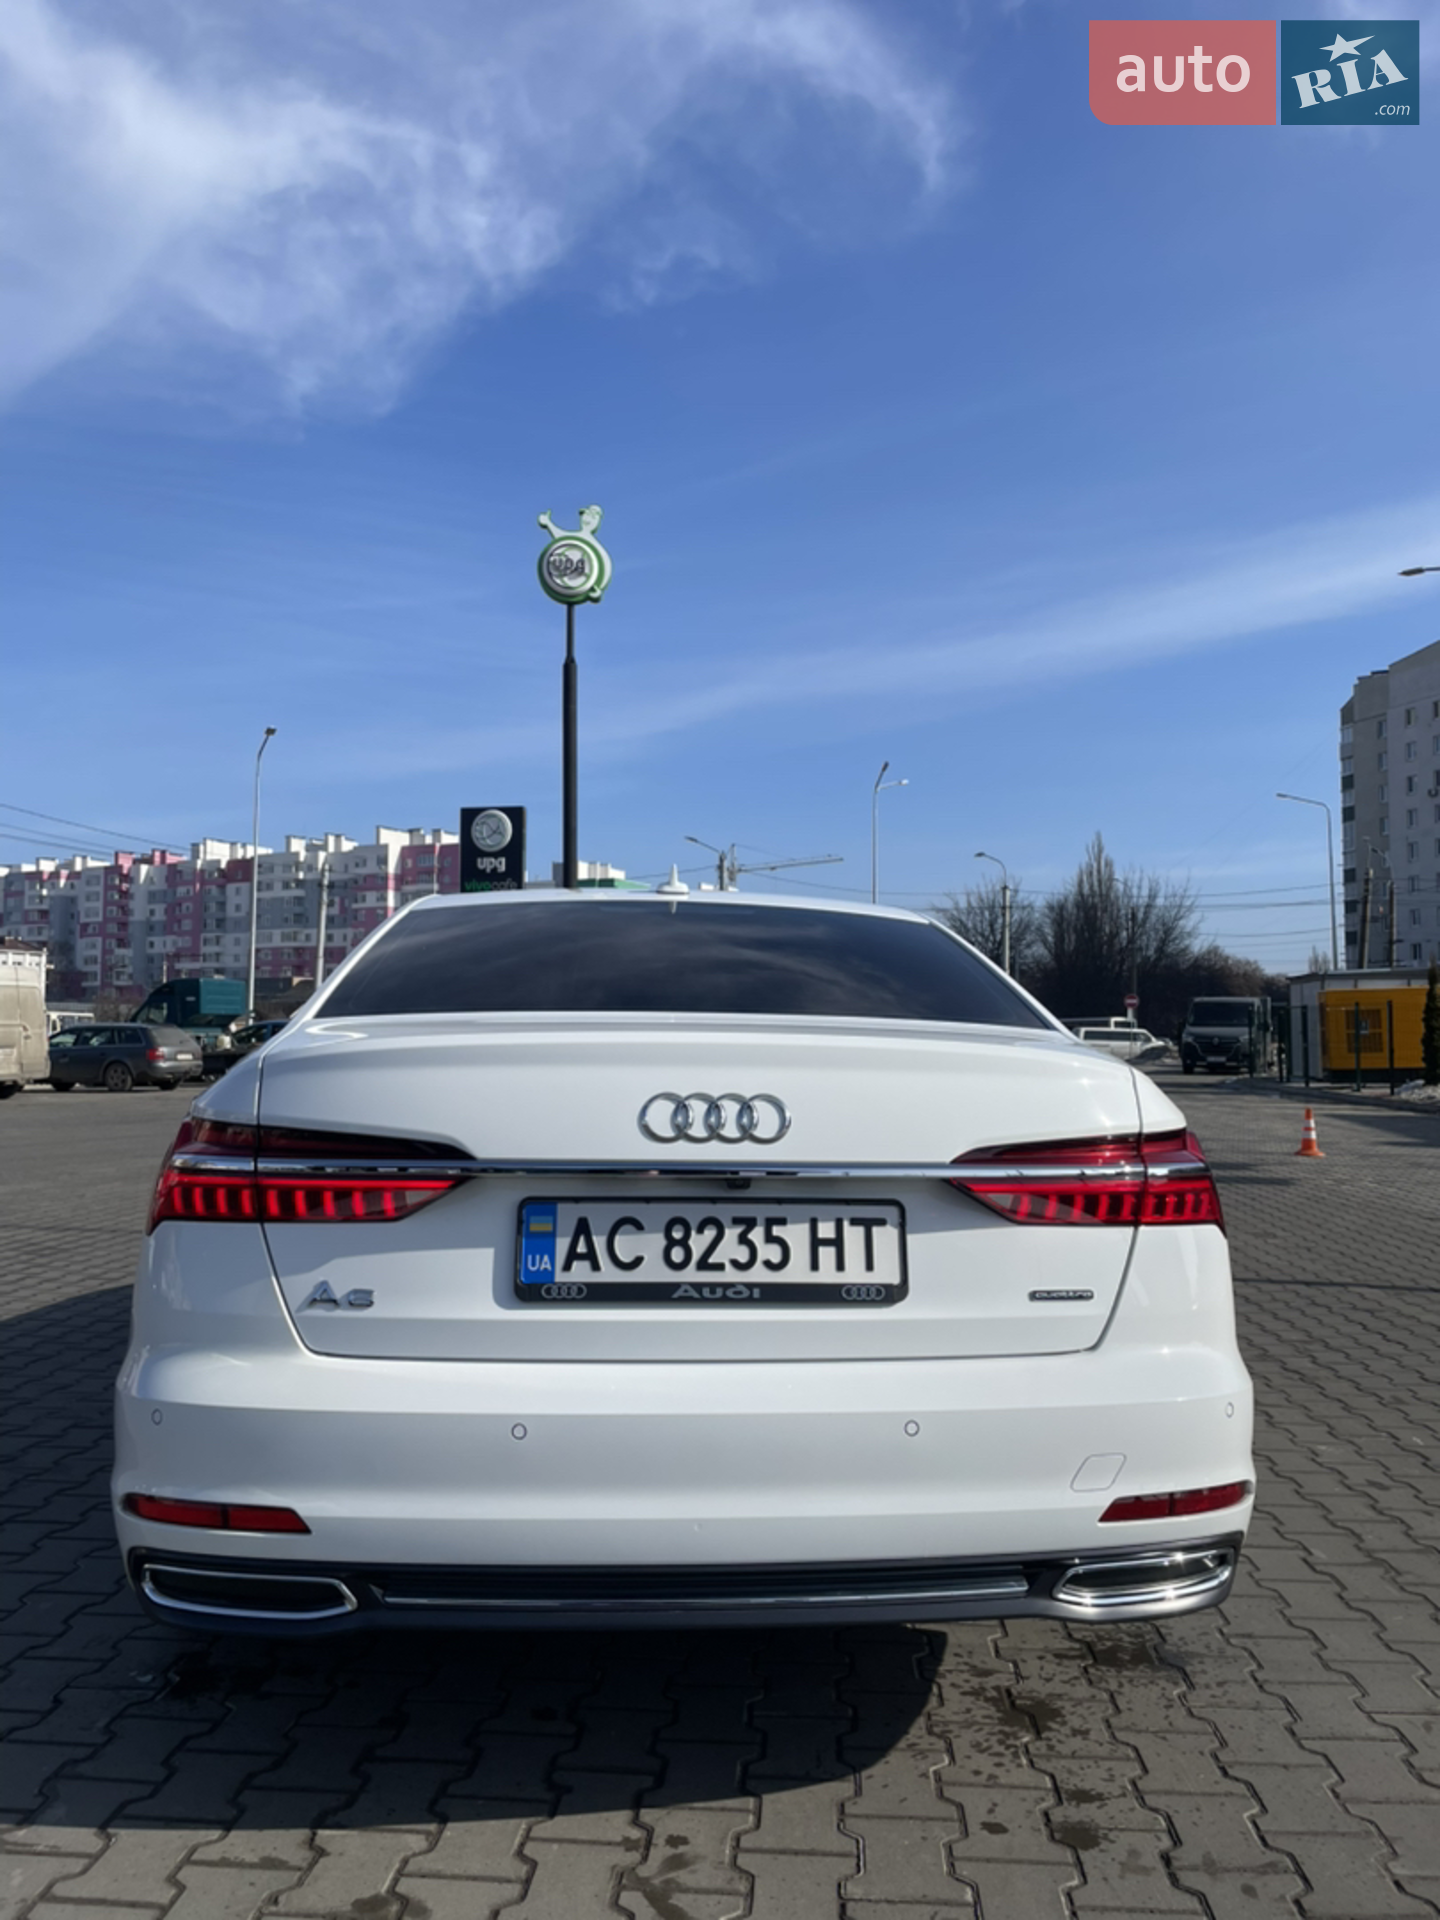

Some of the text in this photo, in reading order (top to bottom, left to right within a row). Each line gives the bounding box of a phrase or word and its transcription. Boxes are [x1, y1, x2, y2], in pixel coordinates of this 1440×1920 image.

[477, 856, 506, 873] upg
[561, 1216, 888, 1272] AC 8235 HT
[527, 1254, 552, 1272] UA
[299, 1280, 375, 1312] A6
[671, 1284, 761, 1298] Audi
